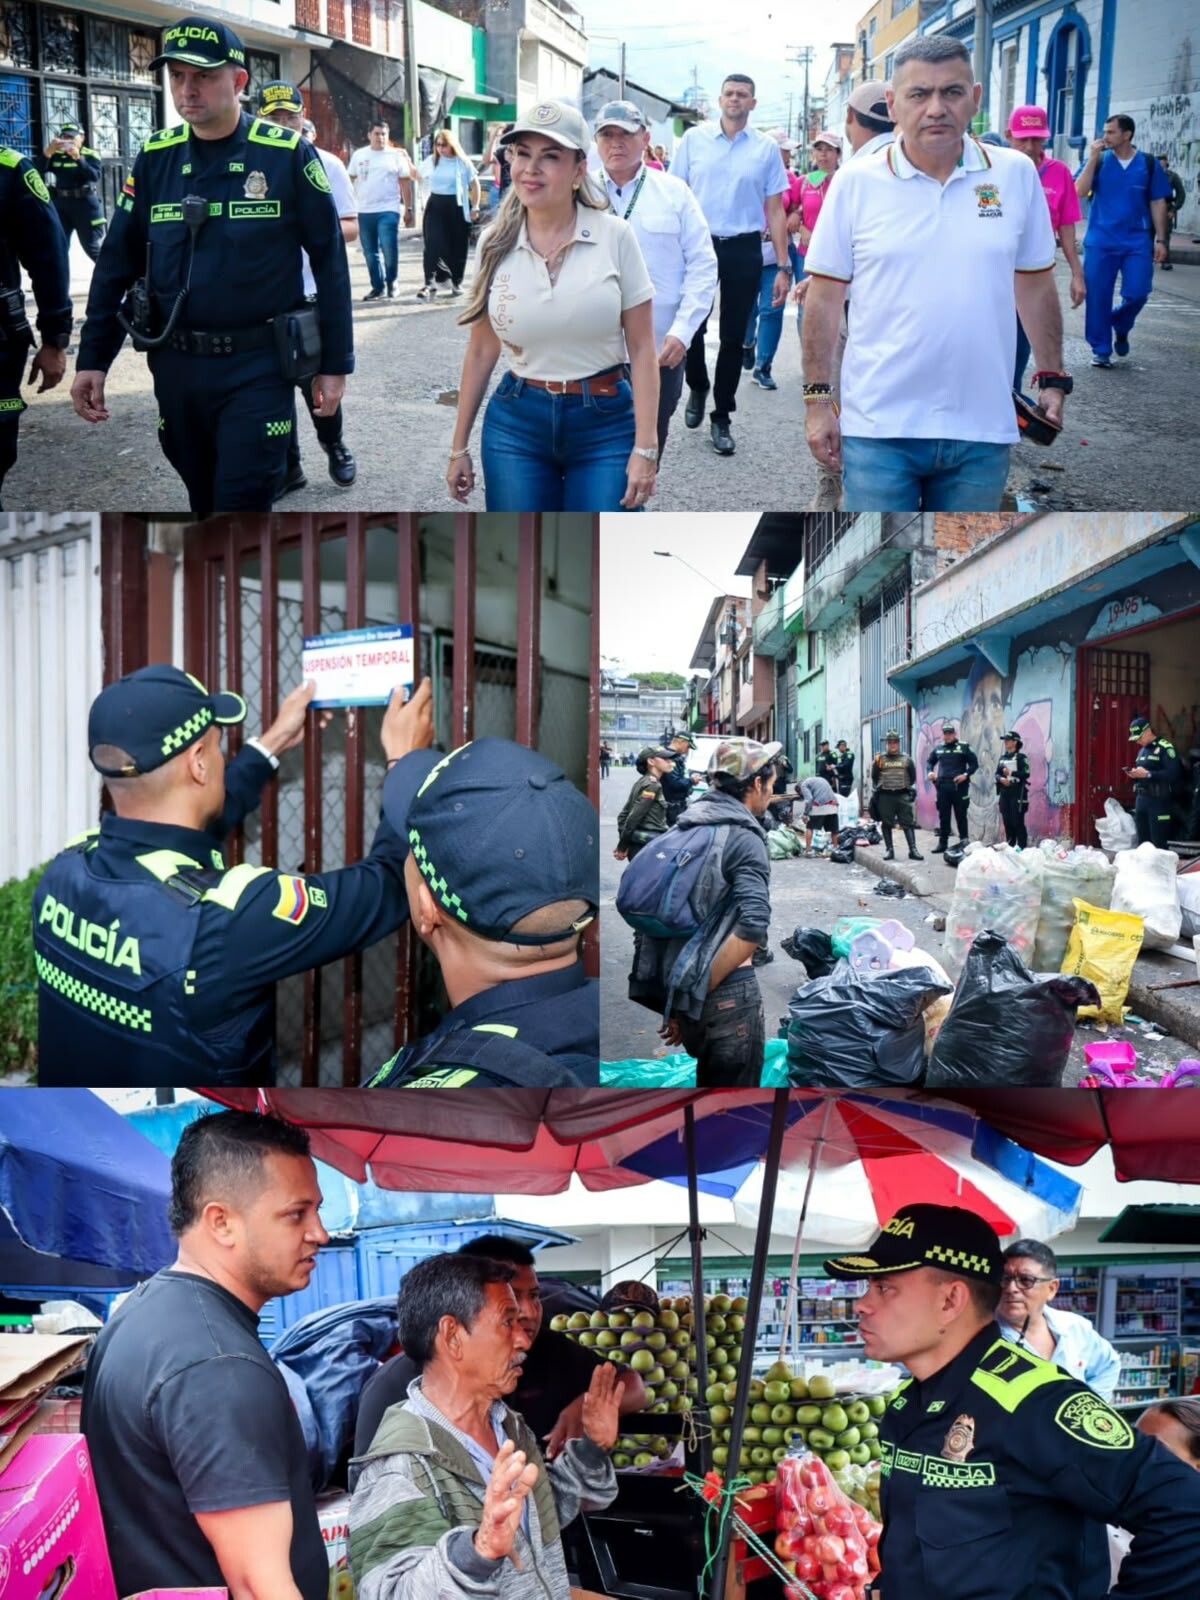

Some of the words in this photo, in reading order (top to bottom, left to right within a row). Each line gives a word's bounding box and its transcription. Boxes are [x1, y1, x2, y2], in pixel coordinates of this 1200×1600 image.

[165, 26, 220, 44] POLICÍA
[234, 204, 276, 215] POLICÍA
[1108, 596, 1139, 625] 19-95
[356, 650, 411, 668] TEMPORAL
[39, 894, 142, 976] POLICÍA
[928, 1462, 987, 1479] POLICÍA
